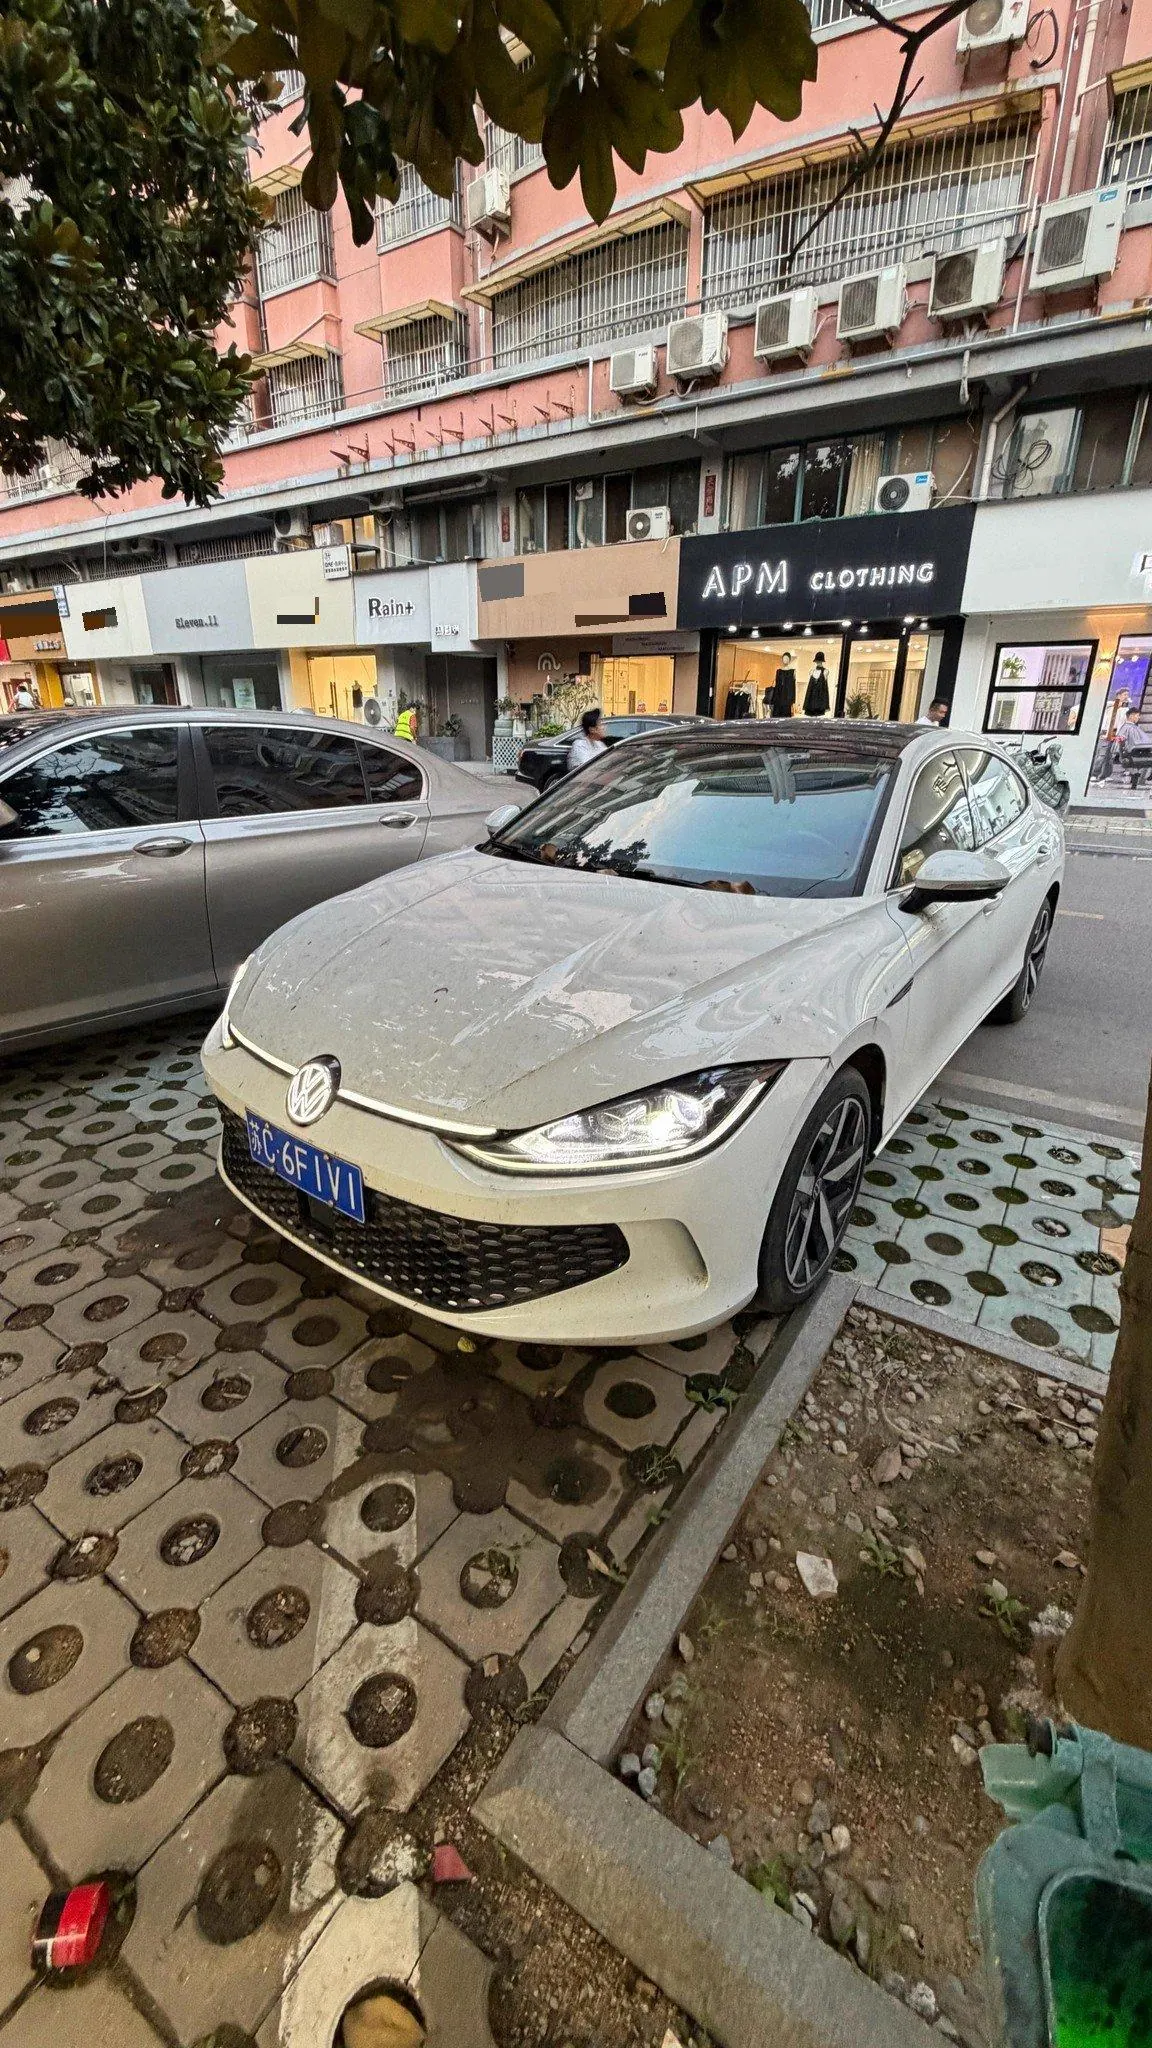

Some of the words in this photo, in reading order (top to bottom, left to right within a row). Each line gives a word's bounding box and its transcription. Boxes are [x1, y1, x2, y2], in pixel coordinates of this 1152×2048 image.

[702, 560, 788, 598] APM
[810, 562, 934, 590] CLOTHING
[368, 598, 414, 617] Rain+
